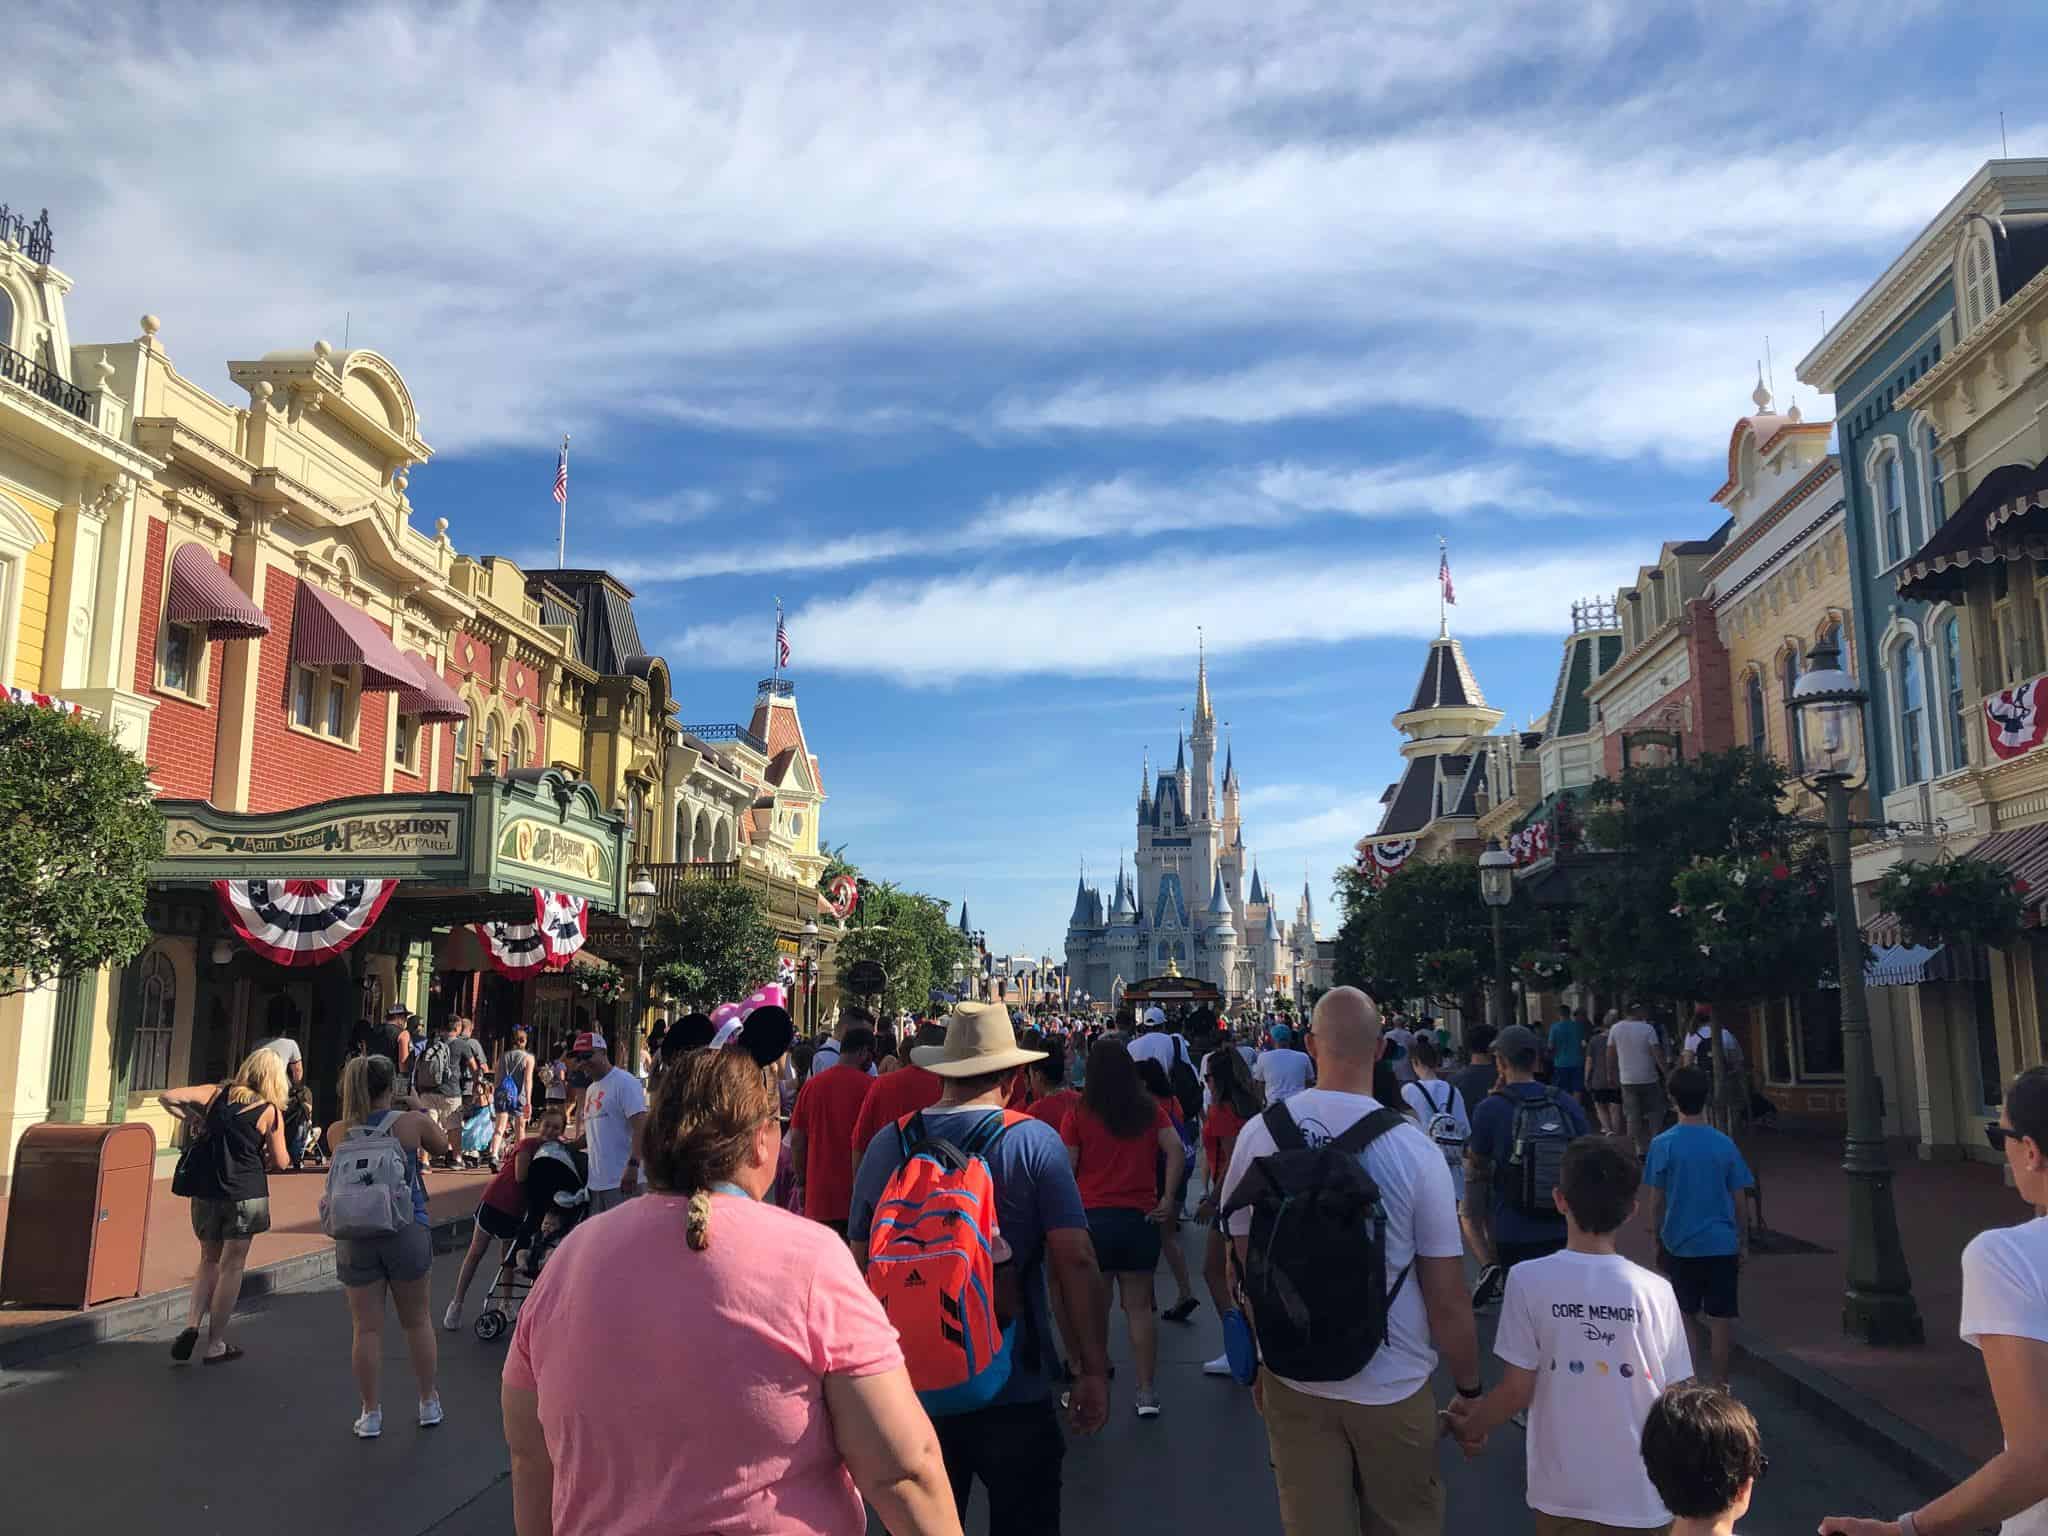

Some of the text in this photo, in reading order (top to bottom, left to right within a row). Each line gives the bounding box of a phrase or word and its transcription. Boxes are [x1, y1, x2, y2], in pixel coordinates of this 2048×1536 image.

[243, 819, 451, 853] Main Street FASHION
[393, 836, 455, 852] APPAREL
[585, 932, 619, 945] OUSE
[1551, 1303, 1584, 1319] CORE
